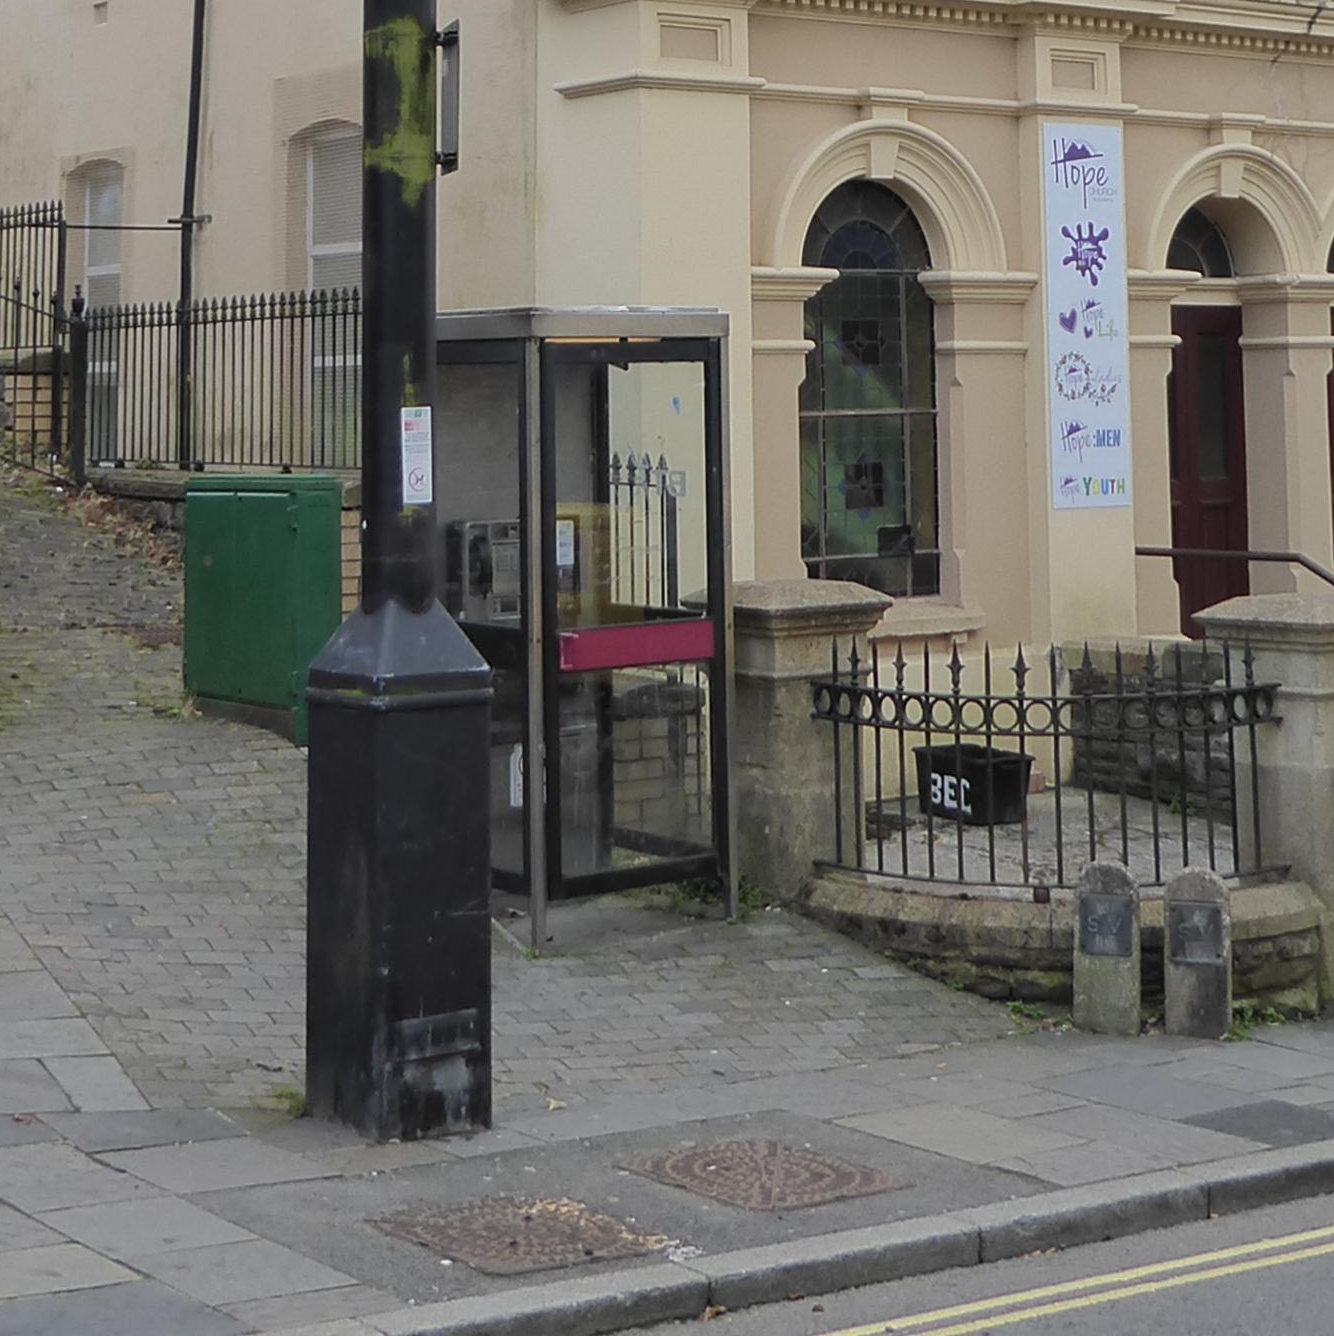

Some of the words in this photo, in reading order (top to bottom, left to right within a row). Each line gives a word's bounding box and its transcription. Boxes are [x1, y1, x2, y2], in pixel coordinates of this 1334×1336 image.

[1051, 137, 1109, 210] Hope
[1080, 296, 1104, 330] Hope
[1083, 476, 1126, 497] YOUTH
